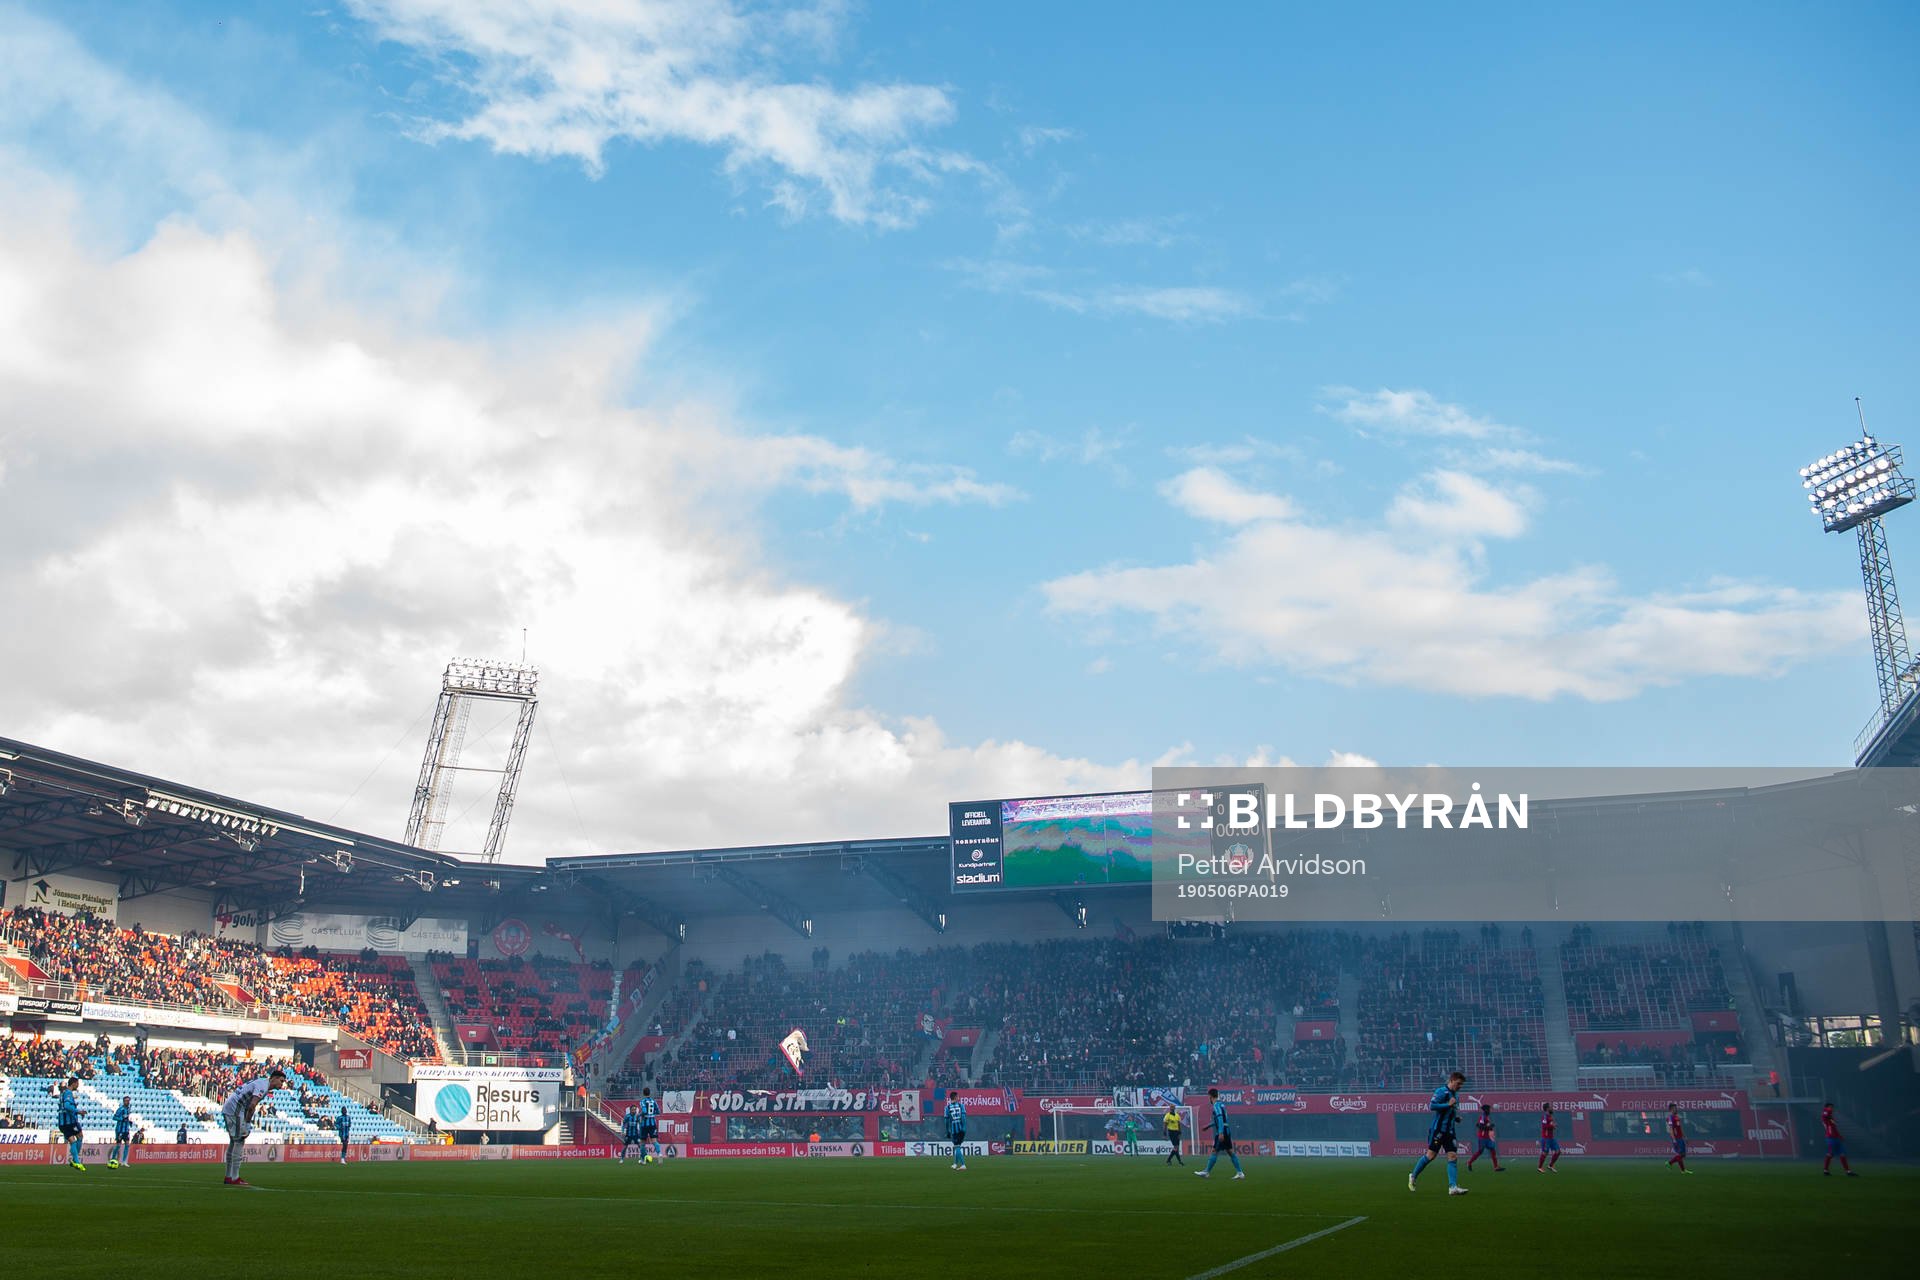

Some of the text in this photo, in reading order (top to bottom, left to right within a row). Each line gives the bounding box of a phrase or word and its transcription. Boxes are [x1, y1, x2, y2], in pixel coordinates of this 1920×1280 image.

[956, 873, 1000, 884] stadium
[311, 926, 362, 937] CASTELLUM
[477, 1085, 540, 1103] Resurs
[1257, 1092, 1296, 1101] UNGDOM
[1329, 1096, 1367, 1111] Carlsberg
[476, 1105, 521, 1122] Bank
[25, 1149, 45, 1160] 1934
[135, 1149, 217, 1159] Tillsammans sedan 1934
[562, 1149, 586, 1157] sedan
[588, 1148, 605, 1156] 1934
[693, 1147, 786, 1155] Tillsammans sedan 1934
